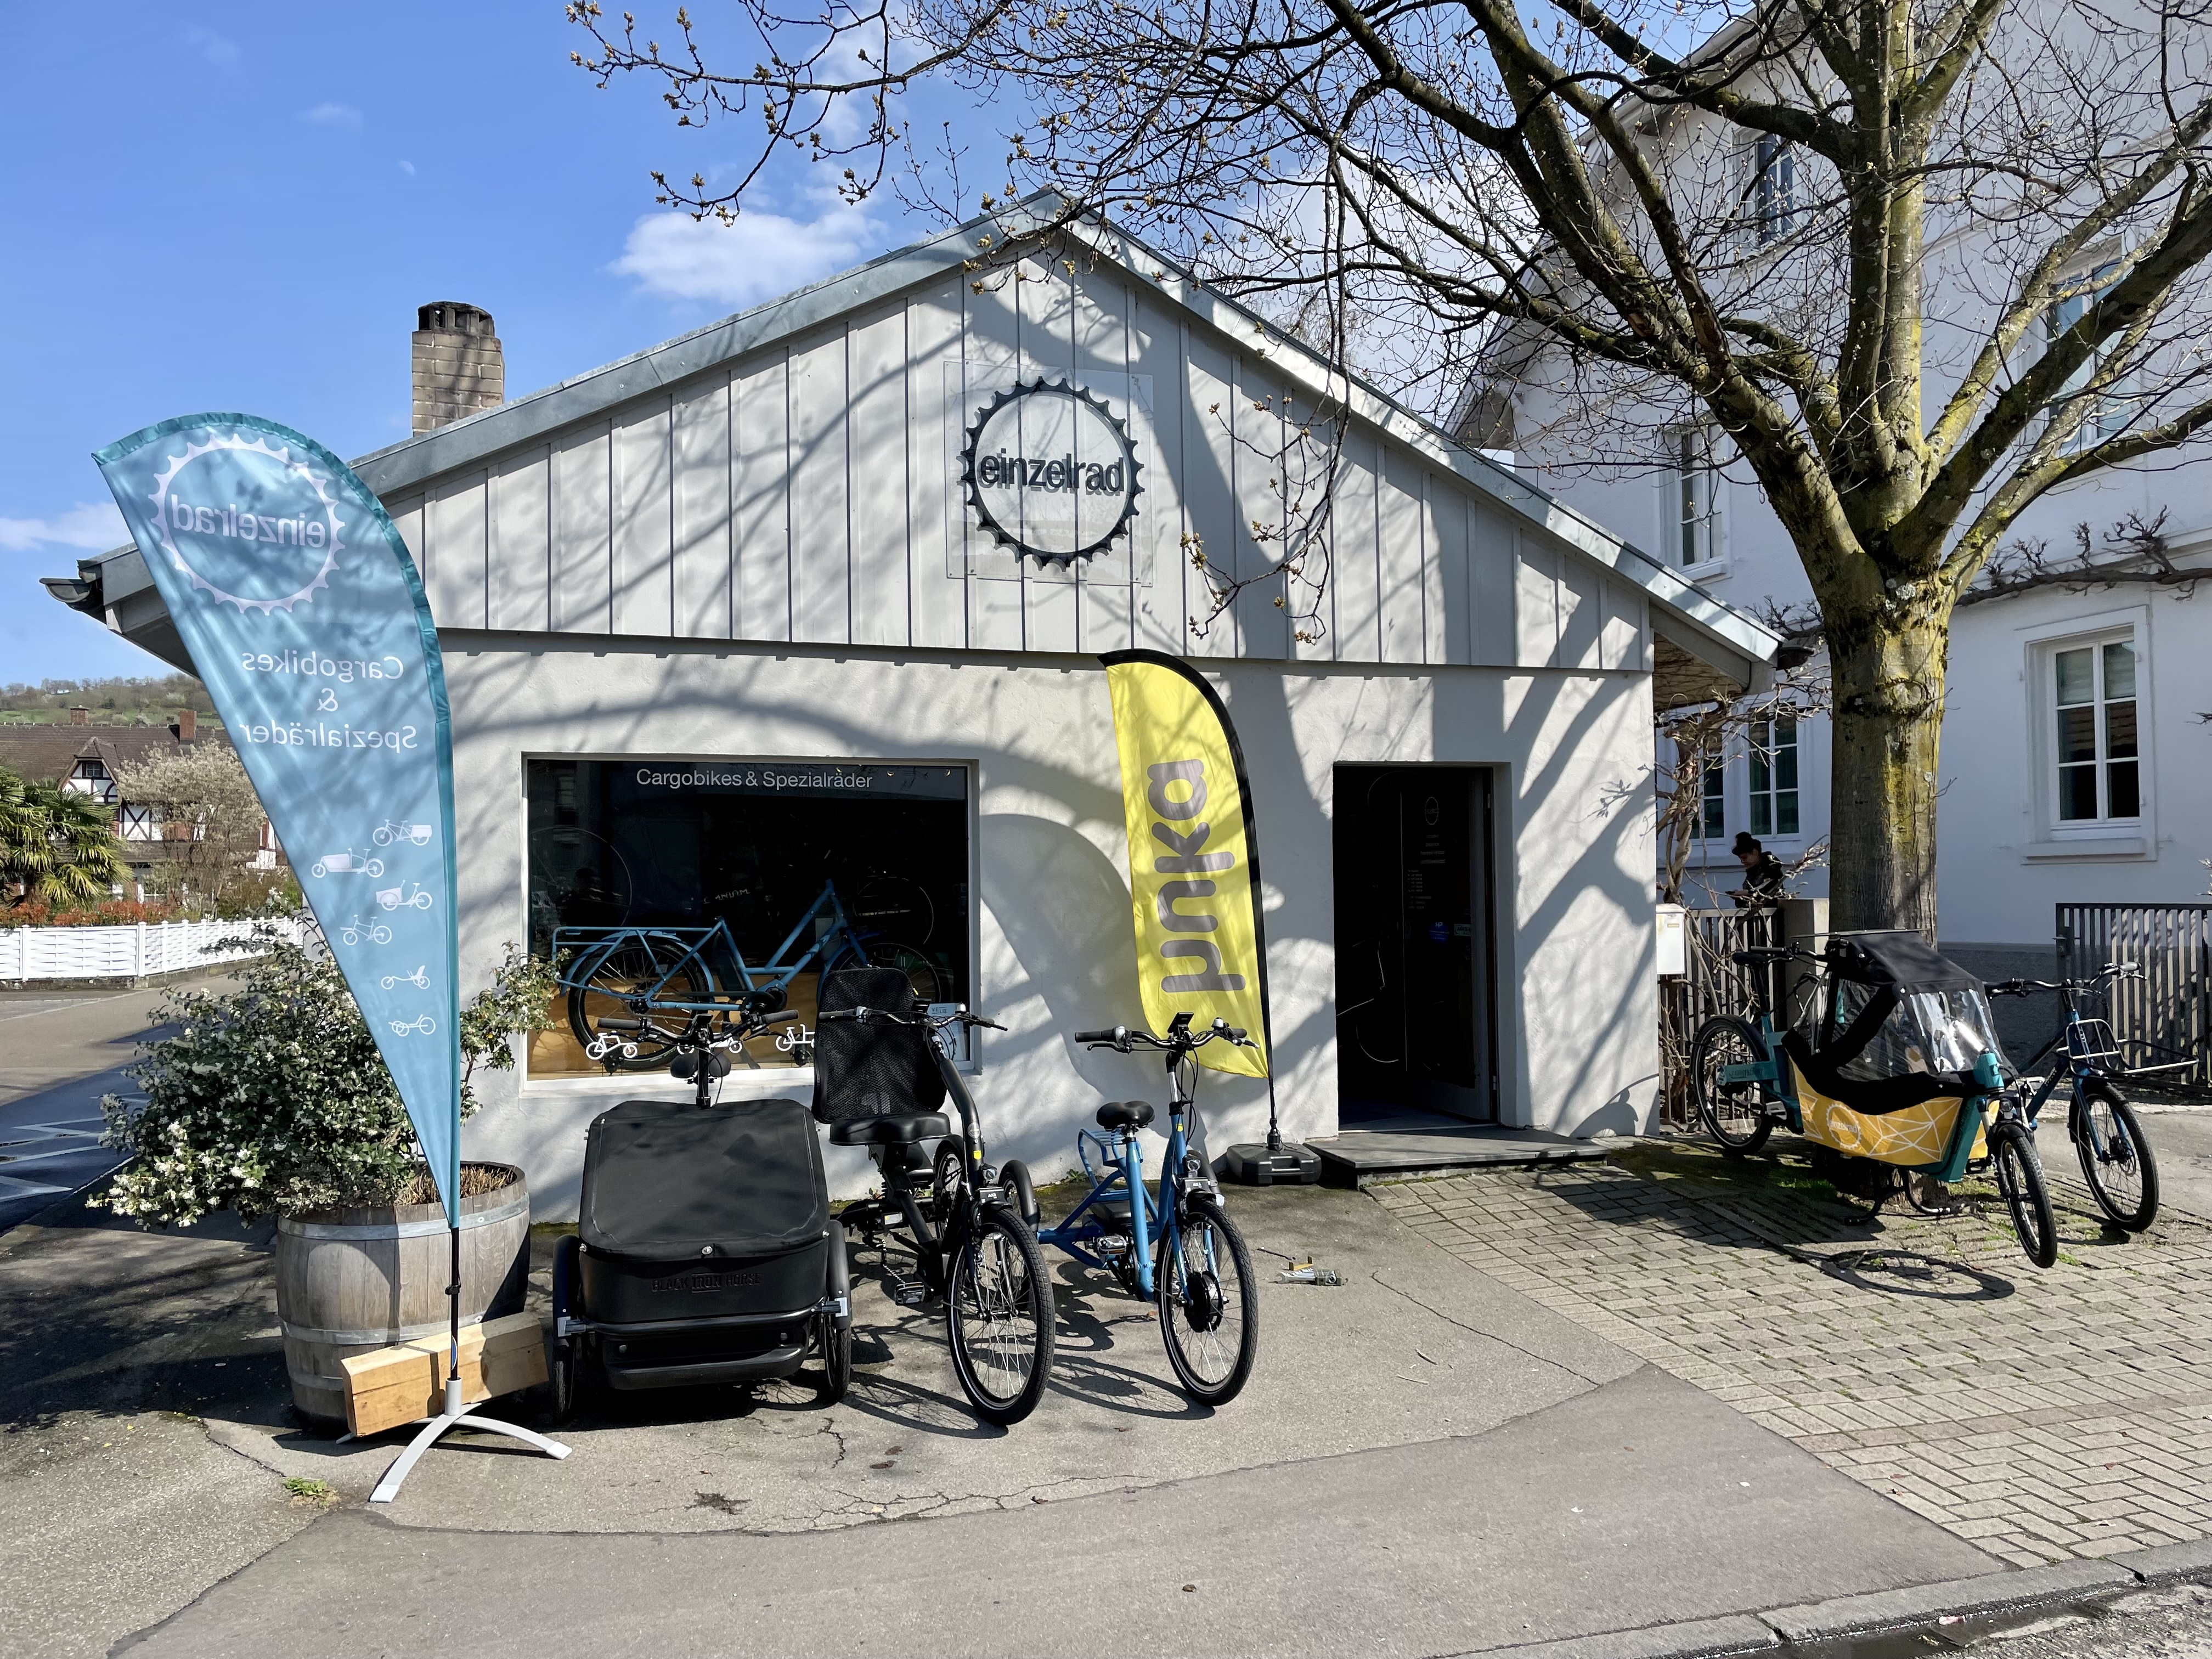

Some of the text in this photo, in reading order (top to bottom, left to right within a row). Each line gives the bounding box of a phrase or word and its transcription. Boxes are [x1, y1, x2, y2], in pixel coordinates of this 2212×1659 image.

[980, 448, 1124, 492] einzelrad
[636, 769, 873, 791] Cargobikes & Spezialräder
[652, 1273, 761, 1293] BLACK IRON HORSE
